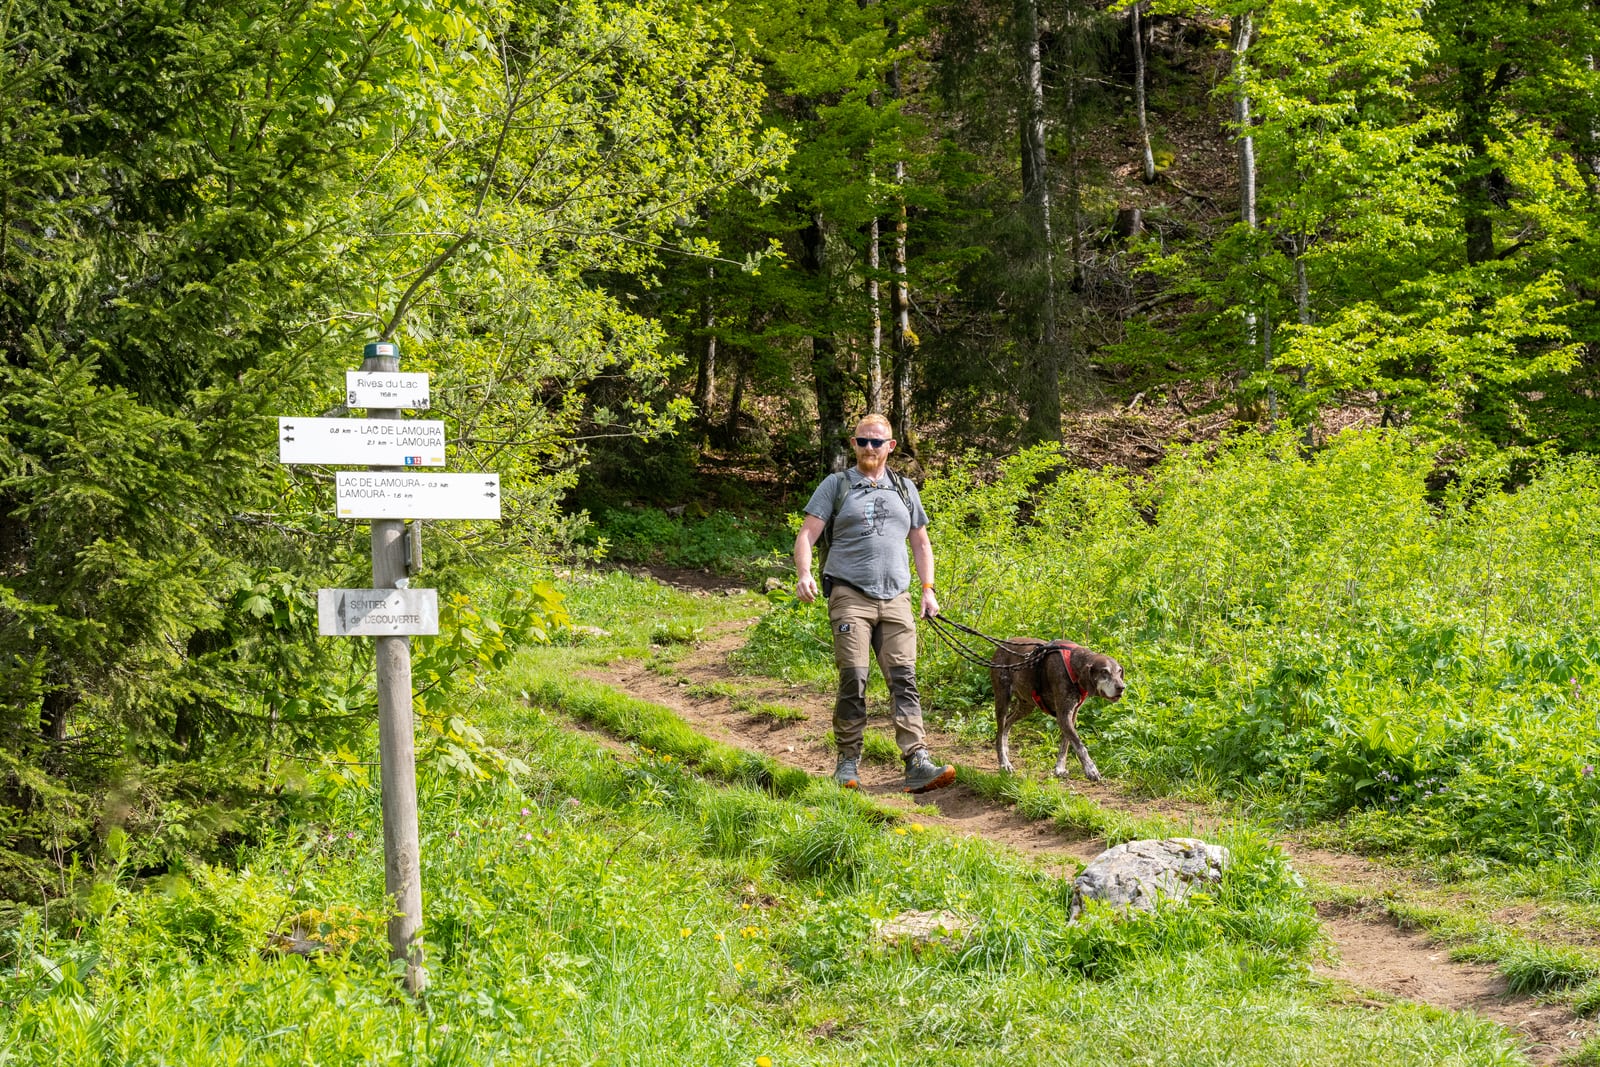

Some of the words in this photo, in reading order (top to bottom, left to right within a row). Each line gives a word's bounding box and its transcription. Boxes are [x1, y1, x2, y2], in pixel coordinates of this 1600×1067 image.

[357, 378, 383, 388] Rives
[385, 379, 398, 388] du
[400, 380, 418, 389] Lac
[360, 425, 379, 435] LAC
[381, 426, 394, 435] DE
[396, 426, 442, 436] LAMOURA
[396, 437, 442, 447] LAMOURA
[339, 478, 357, 487] LAC
[360, 478, 372, 487] DE
[374, 478, 420, 488] LAMOURA
[339, 489, 385, 498] LAMOURA
[350, 600, 387, 609] SENTIER
[350, 616, 360, 624] de
[364, 615, 420, 624] DECOUVERTE
